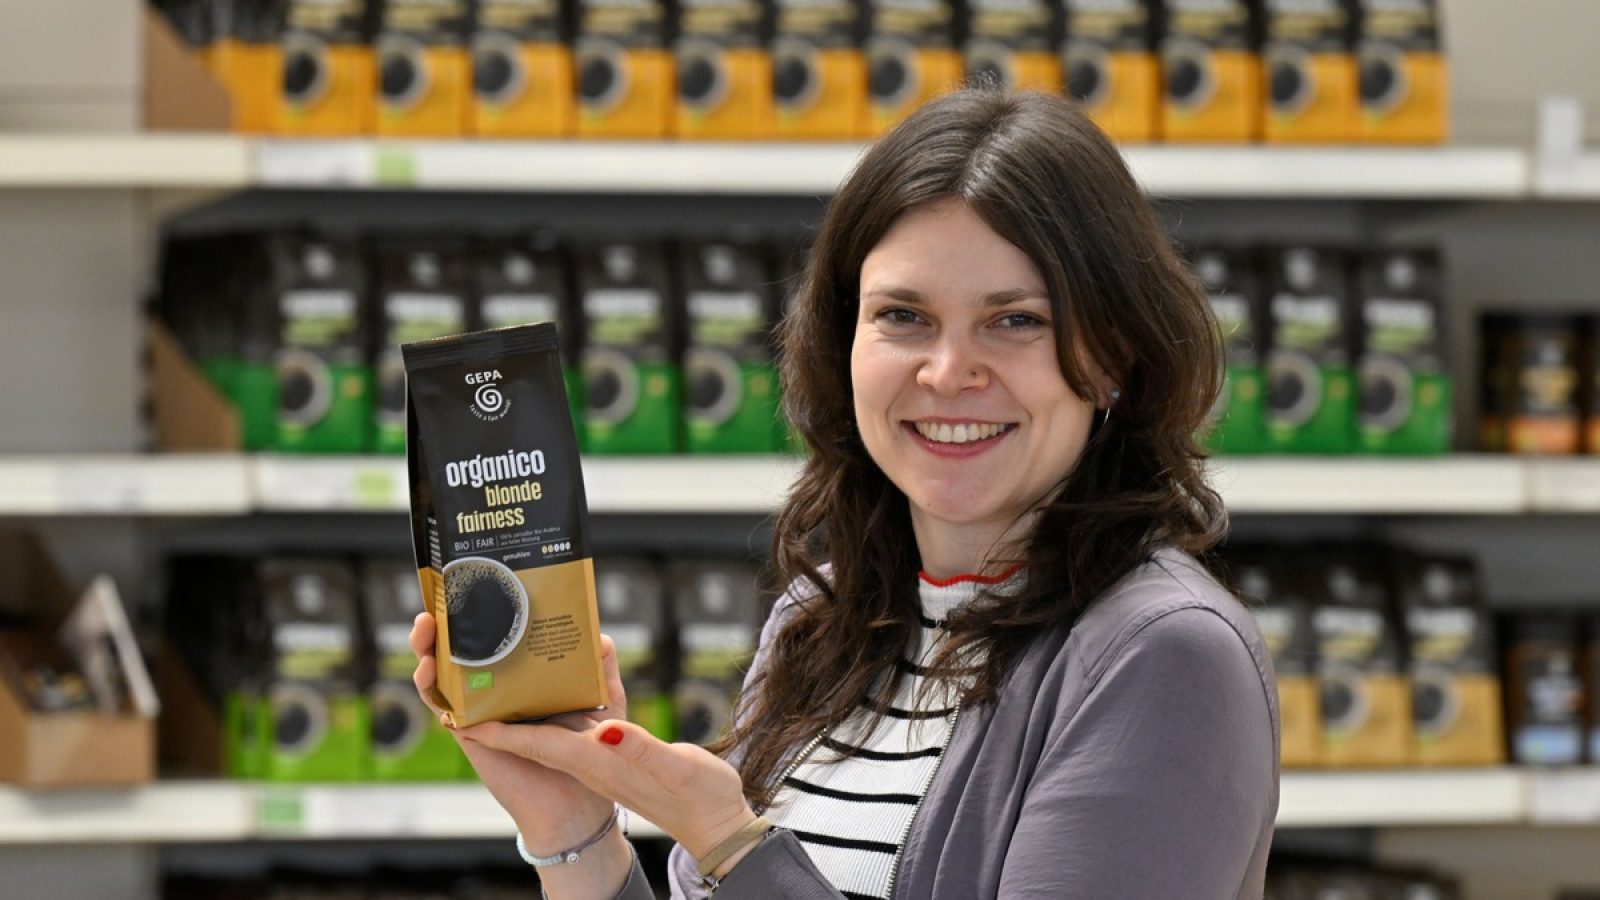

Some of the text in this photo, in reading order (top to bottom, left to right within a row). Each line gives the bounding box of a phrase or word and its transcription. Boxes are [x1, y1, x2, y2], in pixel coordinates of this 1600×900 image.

[464, 369, 503, 385] GEPA
[445, 449, 546, 488] organico
[485, 480, 542, 507] blonde
[456, 507, 525, 534] fairness
[454, 538, 495, 552] BIO FAIR
